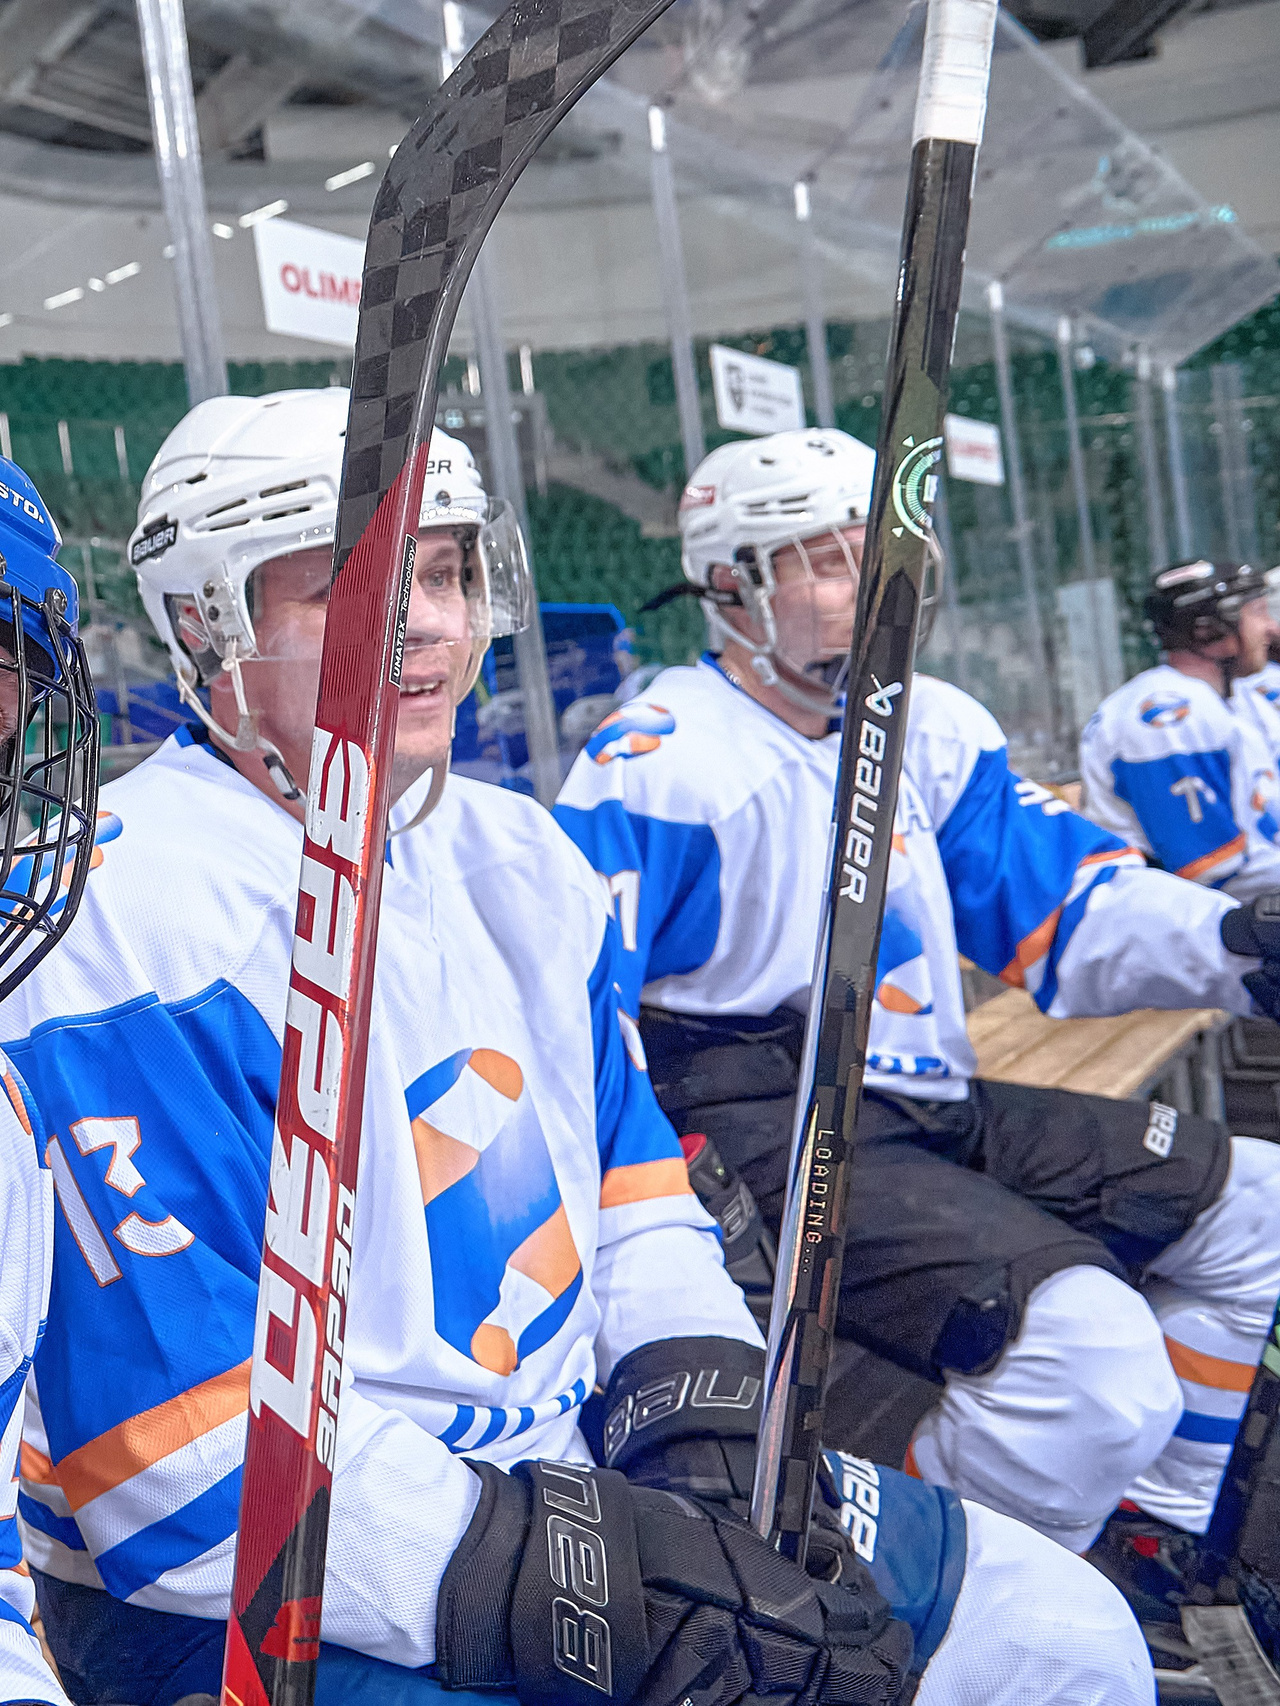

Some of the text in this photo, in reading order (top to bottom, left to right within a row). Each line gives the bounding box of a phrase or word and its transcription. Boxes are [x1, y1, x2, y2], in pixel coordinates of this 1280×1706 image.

[393, 545, 418, 678] UMATEX Technology
[46, 1115, 196, 1288] 13
[604, 1369, 761, 1468] BAU
[841, 1451, 880, 1563] BAU
[539, 1458, 613, 1697] BAU
